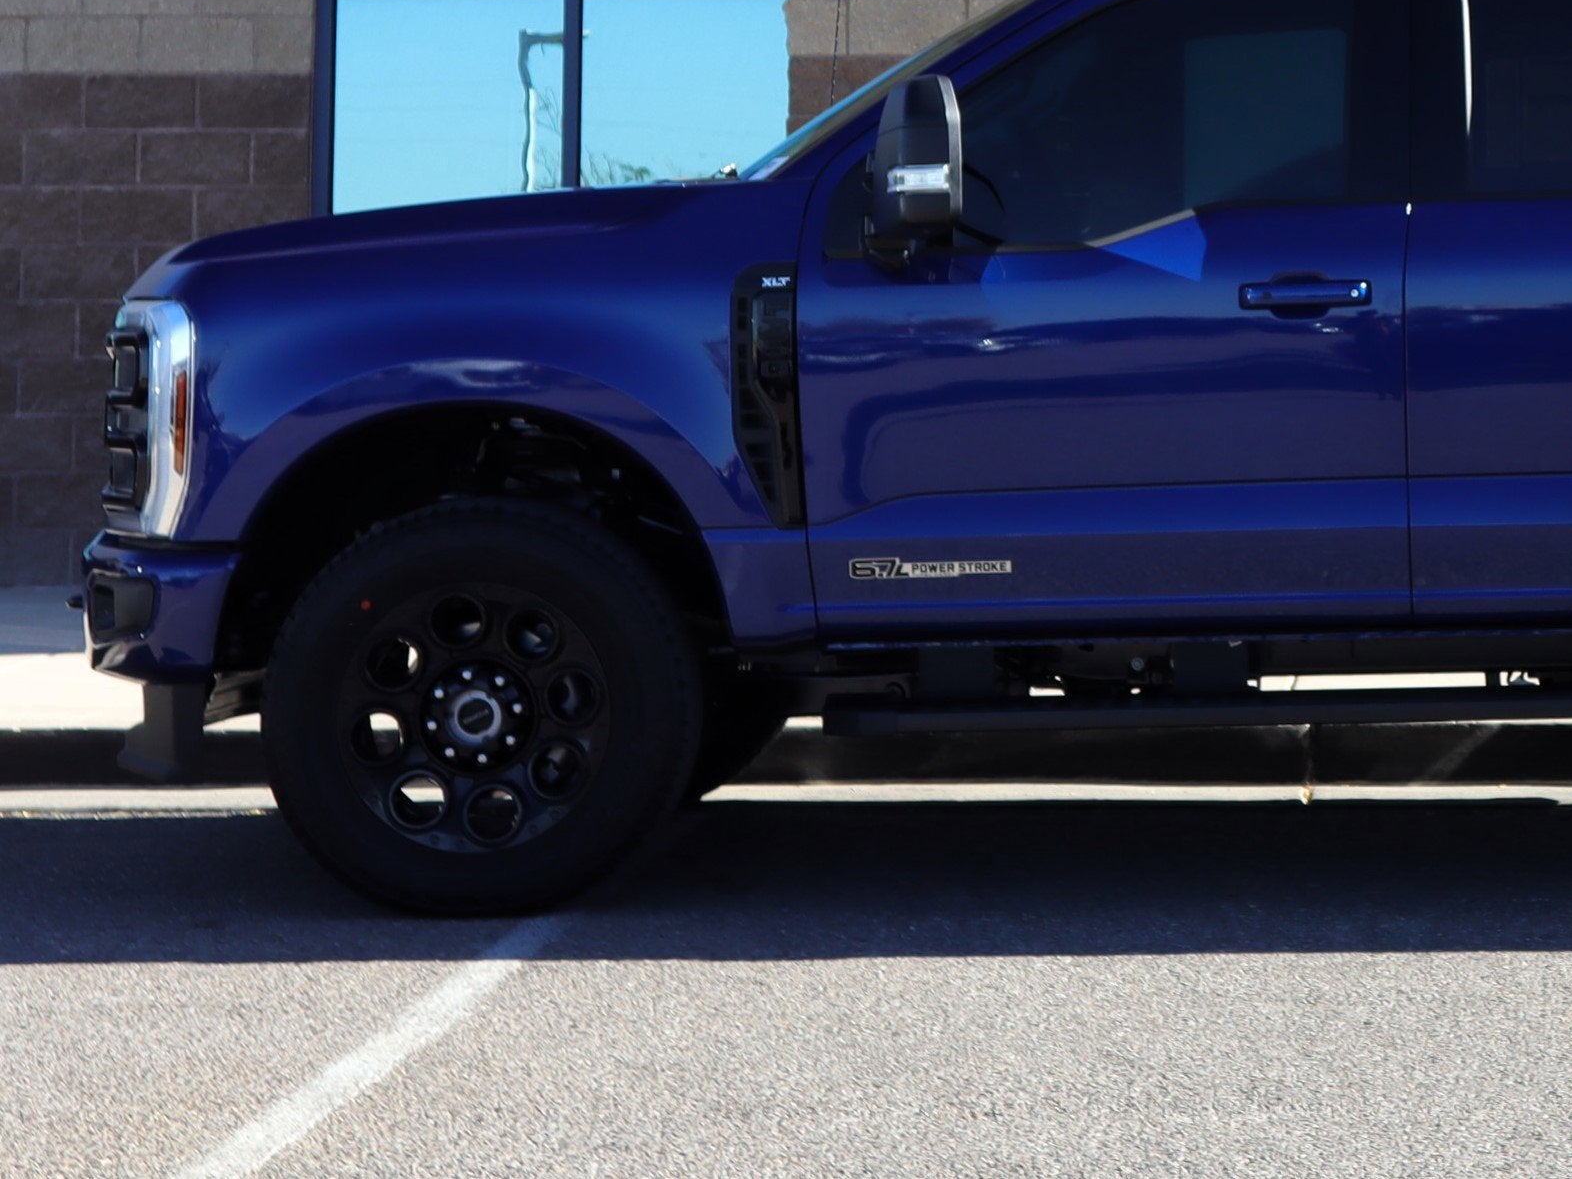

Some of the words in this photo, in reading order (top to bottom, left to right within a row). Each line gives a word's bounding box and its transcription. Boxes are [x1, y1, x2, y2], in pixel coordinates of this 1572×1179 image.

[761, 276, 791, 288] XLT
[911, 562, 955, 574] POWER
[957, 560, 1008, 572] STROKE
